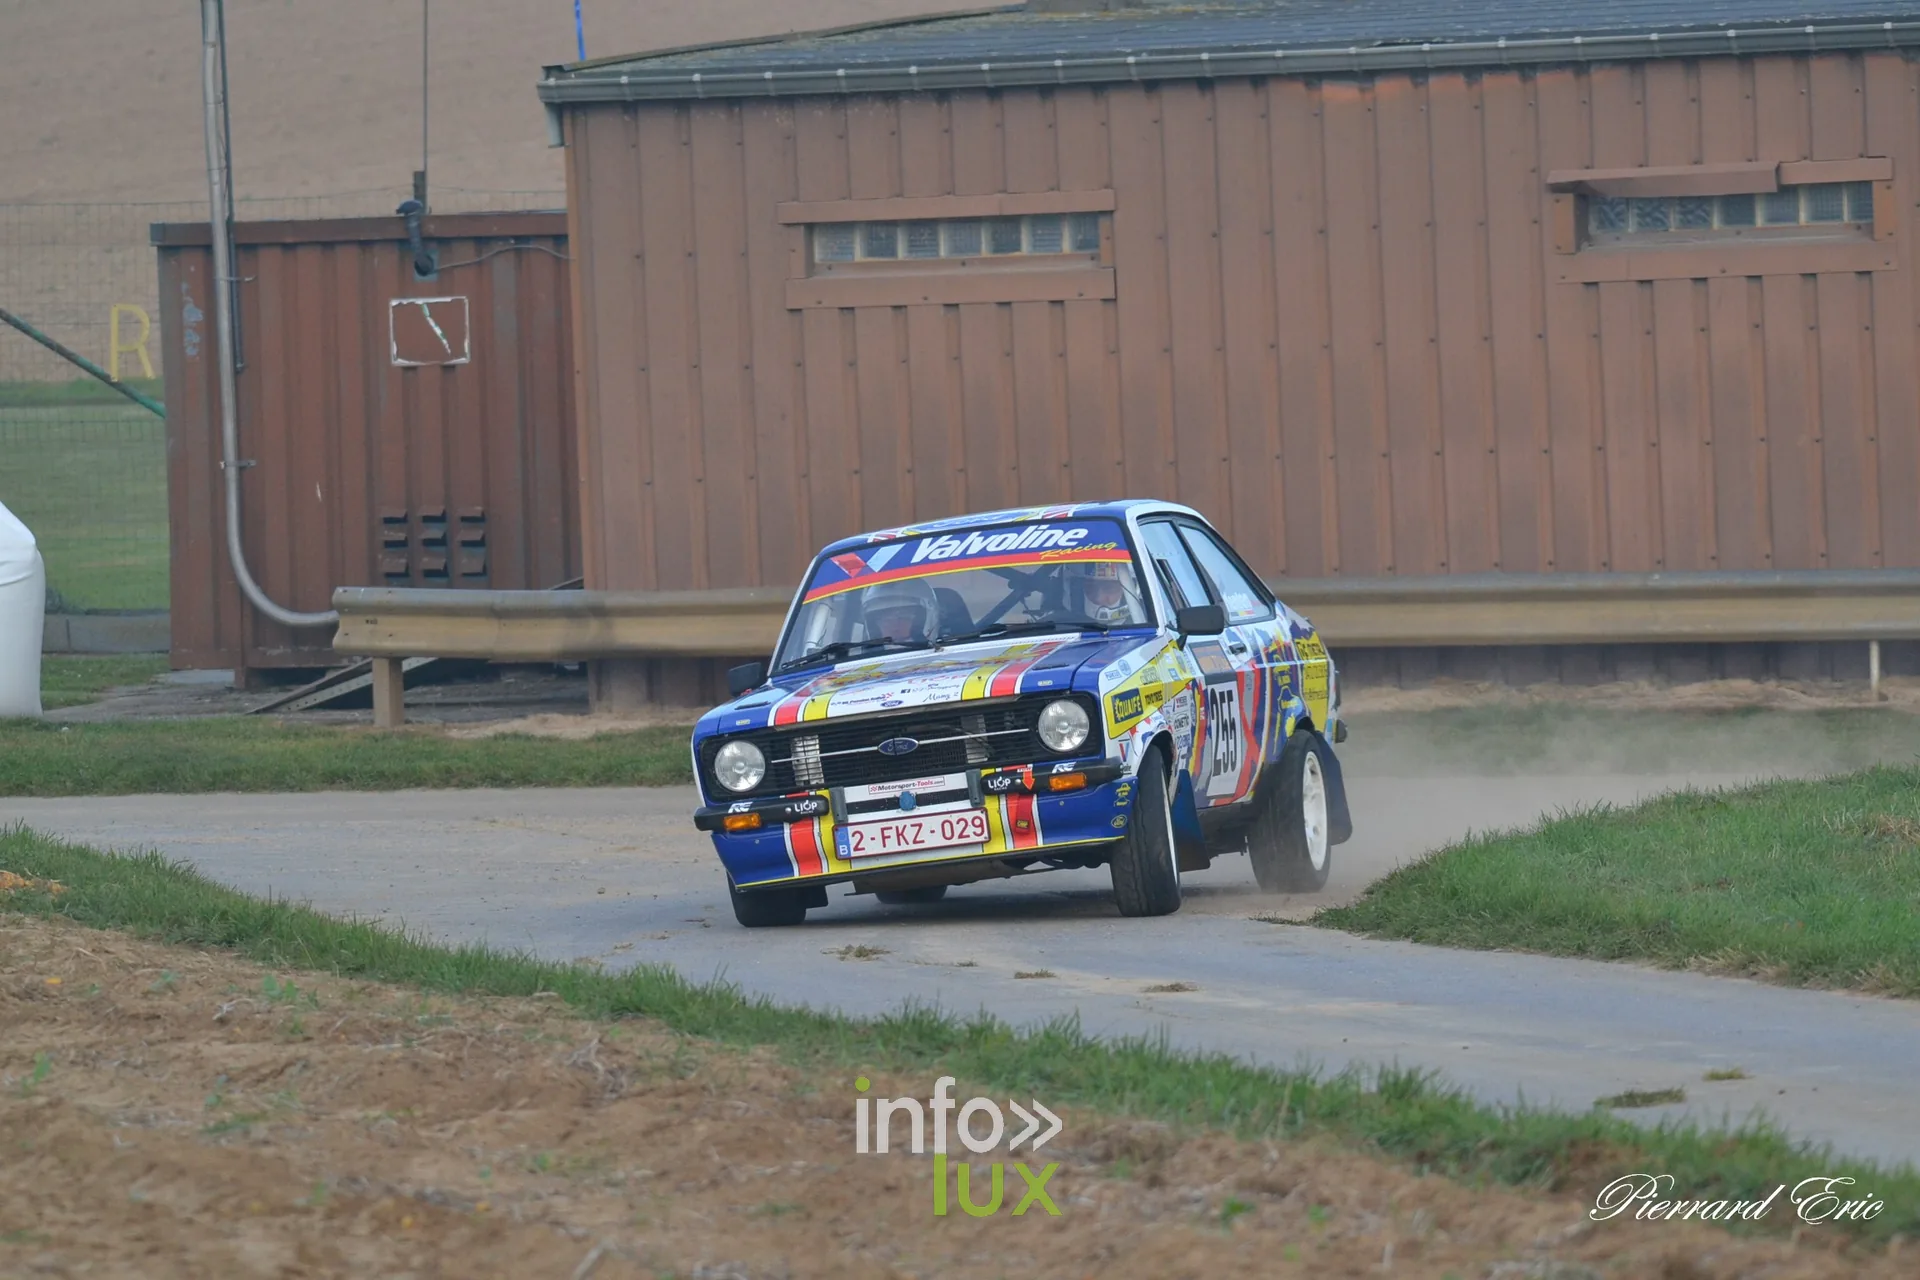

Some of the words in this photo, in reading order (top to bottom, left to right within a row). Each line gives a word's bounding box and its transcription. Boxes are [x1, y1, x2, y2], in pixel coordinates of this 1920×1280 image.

[110, 303, 155, 382] R
[910, 525, 1089, 564] Valvoline
[1039, 540, 1118, 560] Racing
[1209, 688, 1238, 776] 255
[877, 779, 944, 793] Motorsport-Tools.com
[839, 844, 849, 856] B
[851, 815, 986, 853] 2-FKZ-029
